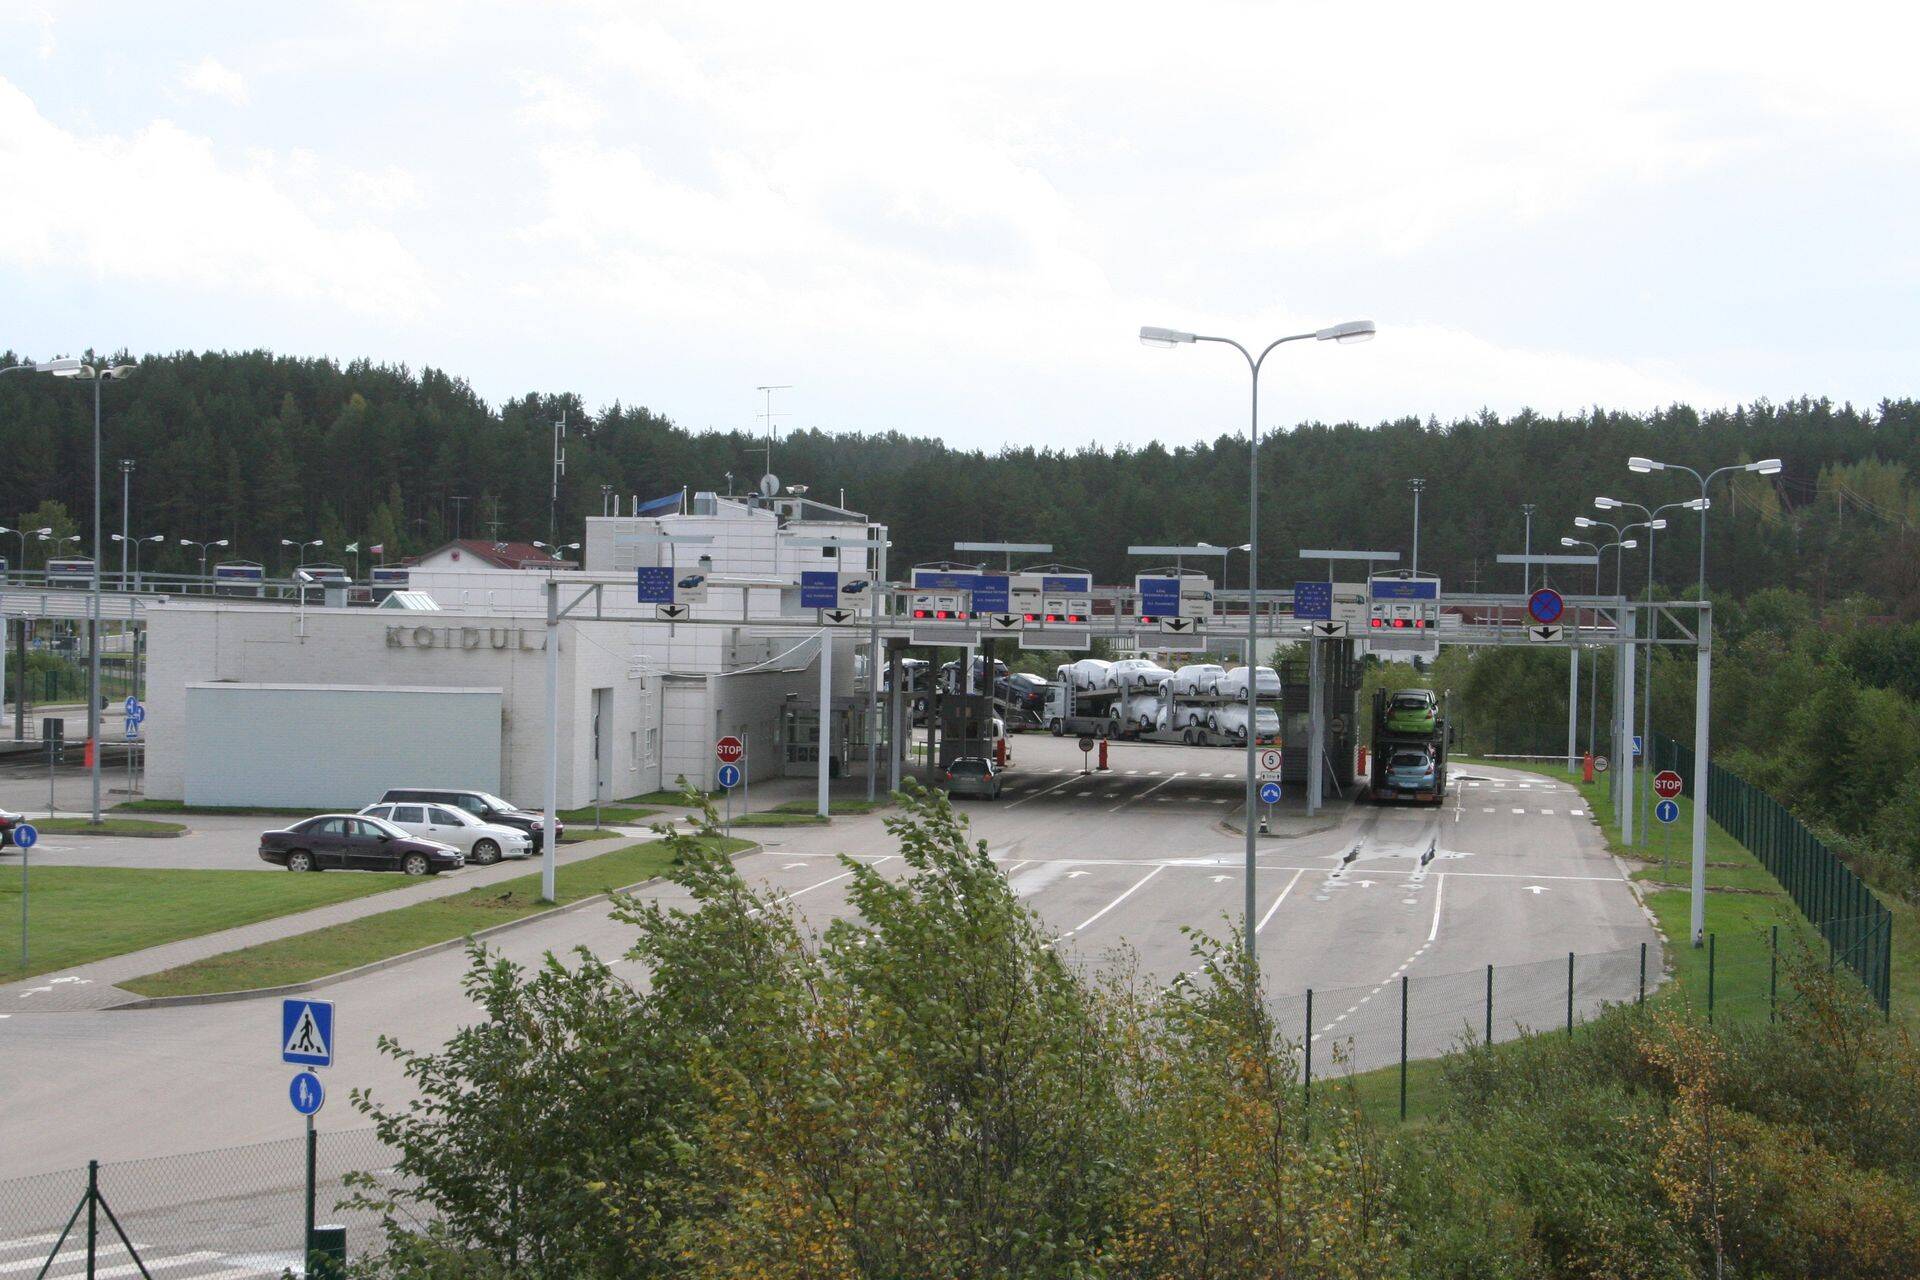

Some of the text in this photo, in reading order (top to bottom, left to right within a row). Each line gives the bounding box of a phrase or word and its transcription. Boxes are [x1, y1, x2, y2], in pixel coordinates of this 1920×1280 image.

[717, 745, 742, 755] STOP
[1268, 755, 1274, 765] 5
[1655, 780, 1681, 790] STOP
